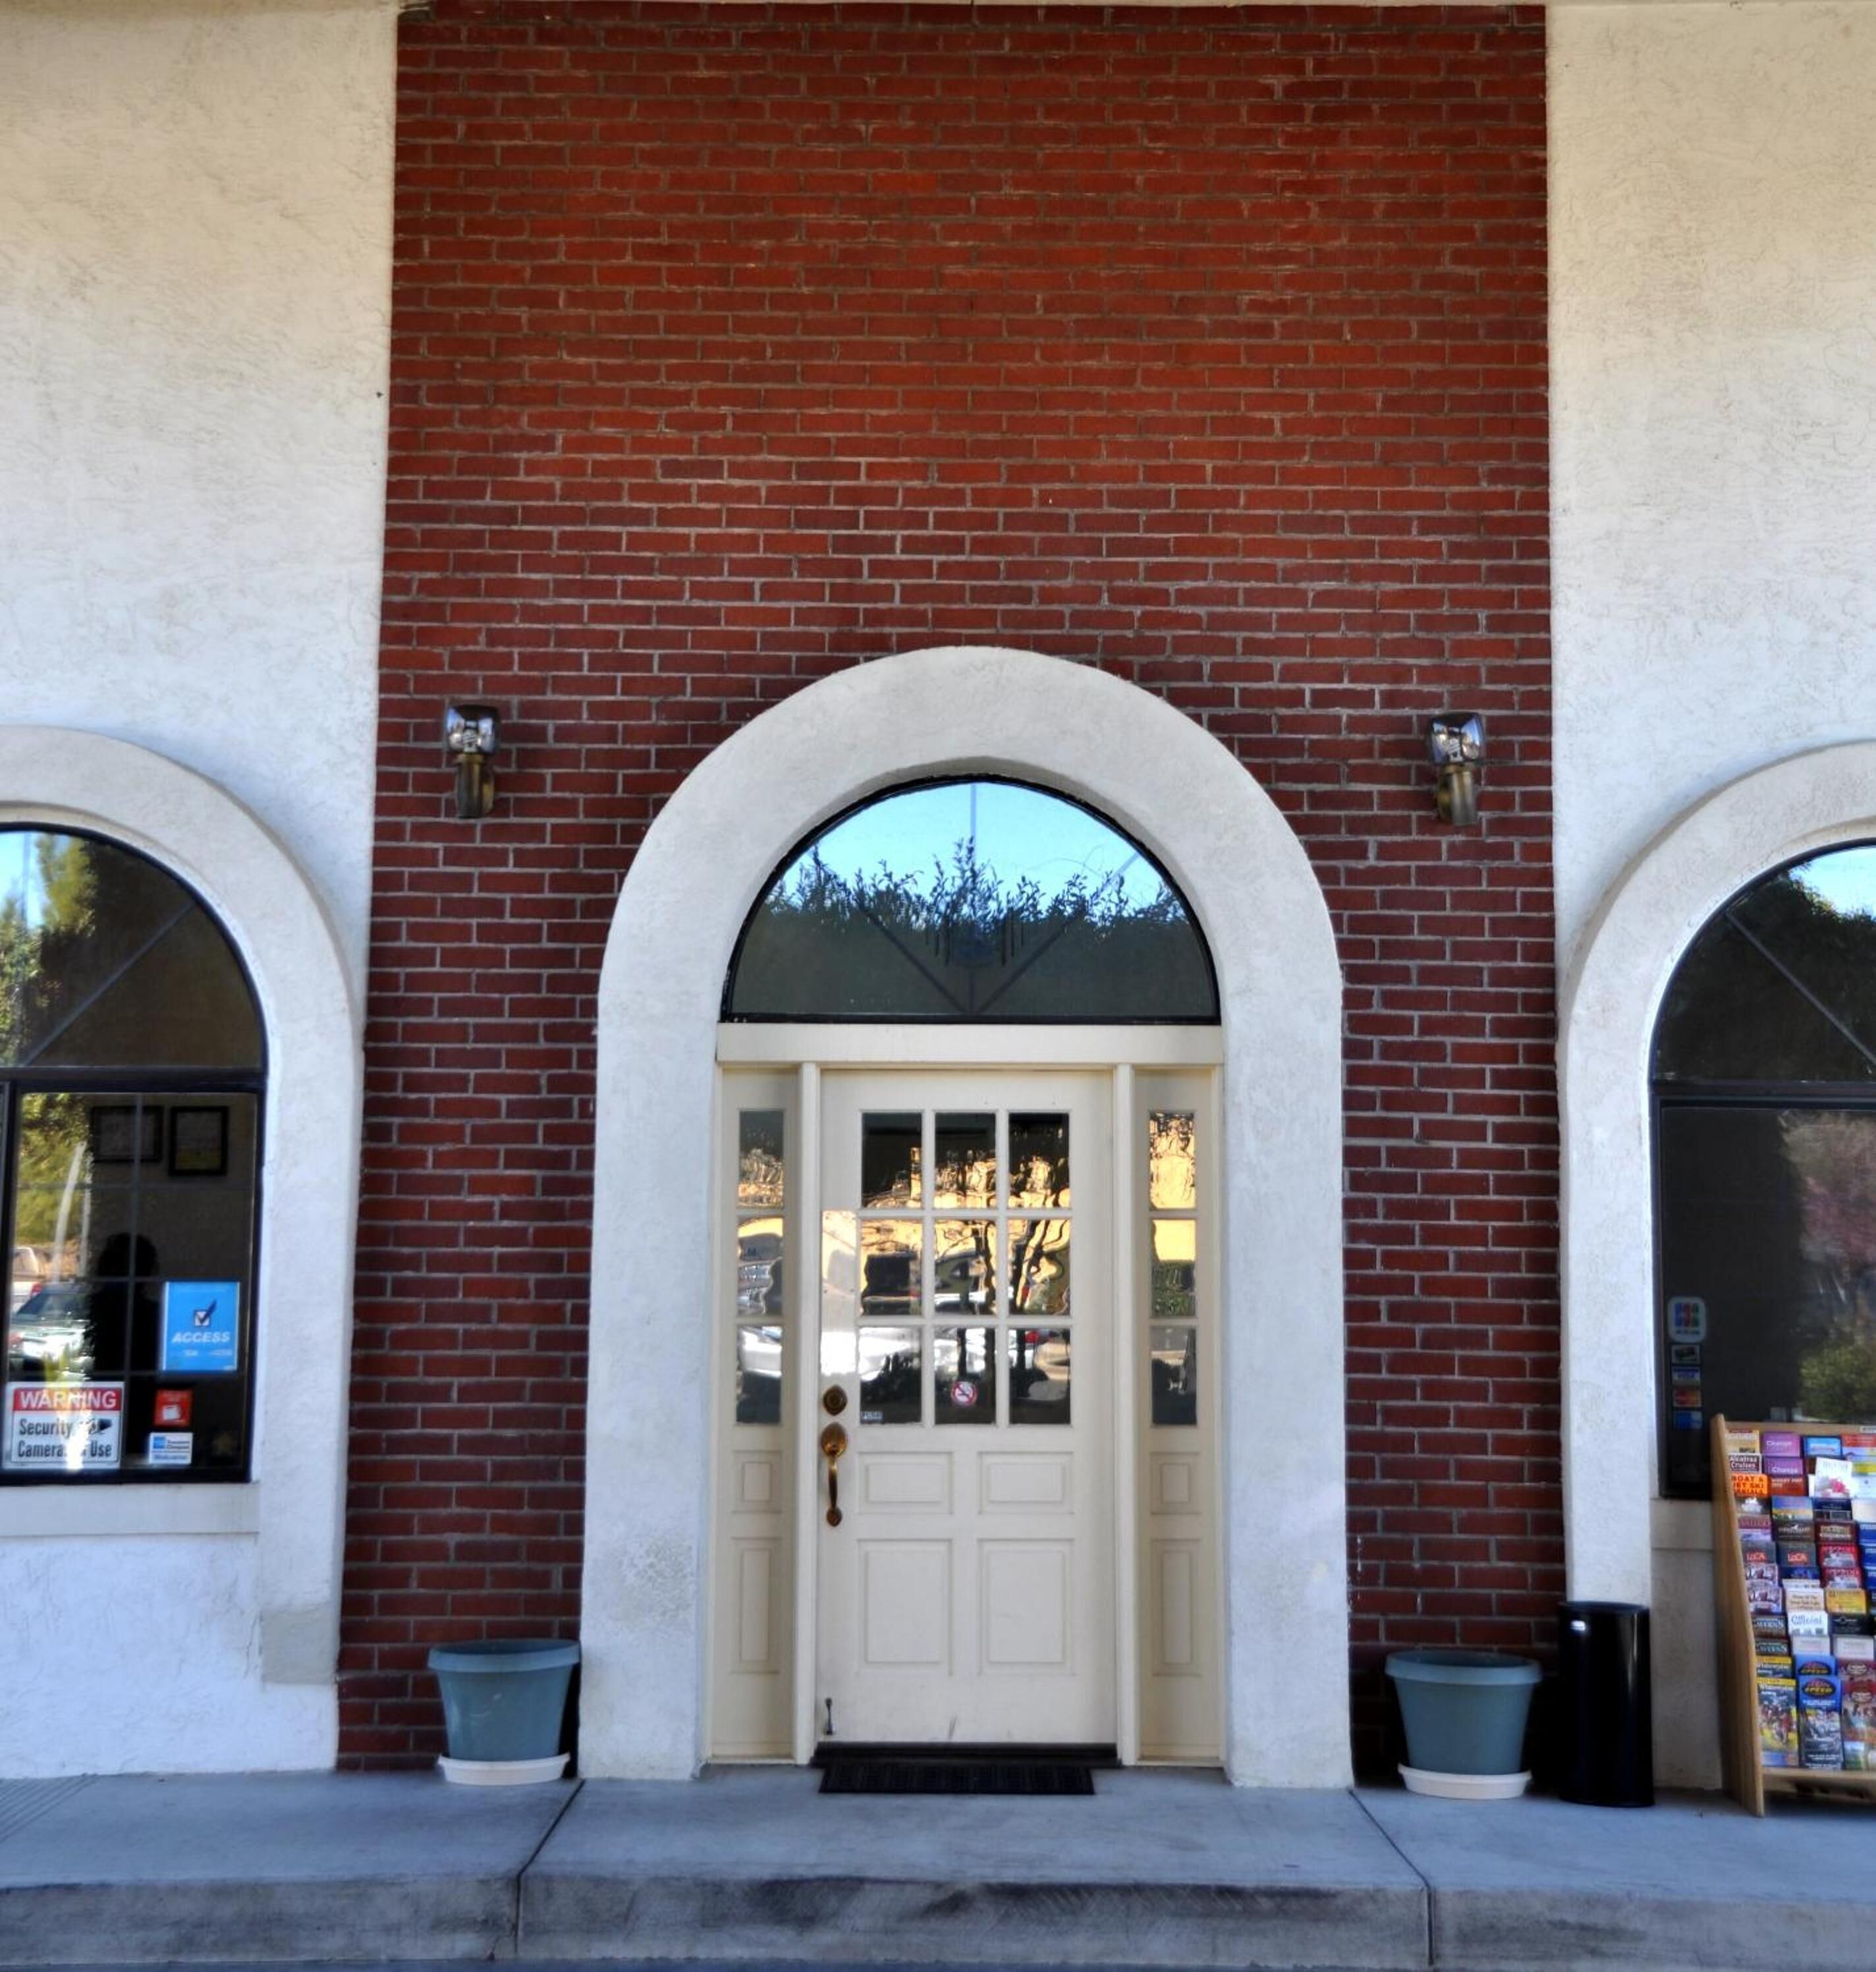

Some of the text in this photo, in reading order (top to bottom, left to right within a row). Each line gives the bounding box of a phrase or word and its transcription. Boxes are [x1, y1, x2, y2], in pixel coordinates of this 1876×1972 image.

[172, 1332, 231, 1343] ACCESS
[20, 1390, 117, 1408] WARNING
[19, 1419, 72, 1438] Security
[90, 1441, 112, 1457] Use
